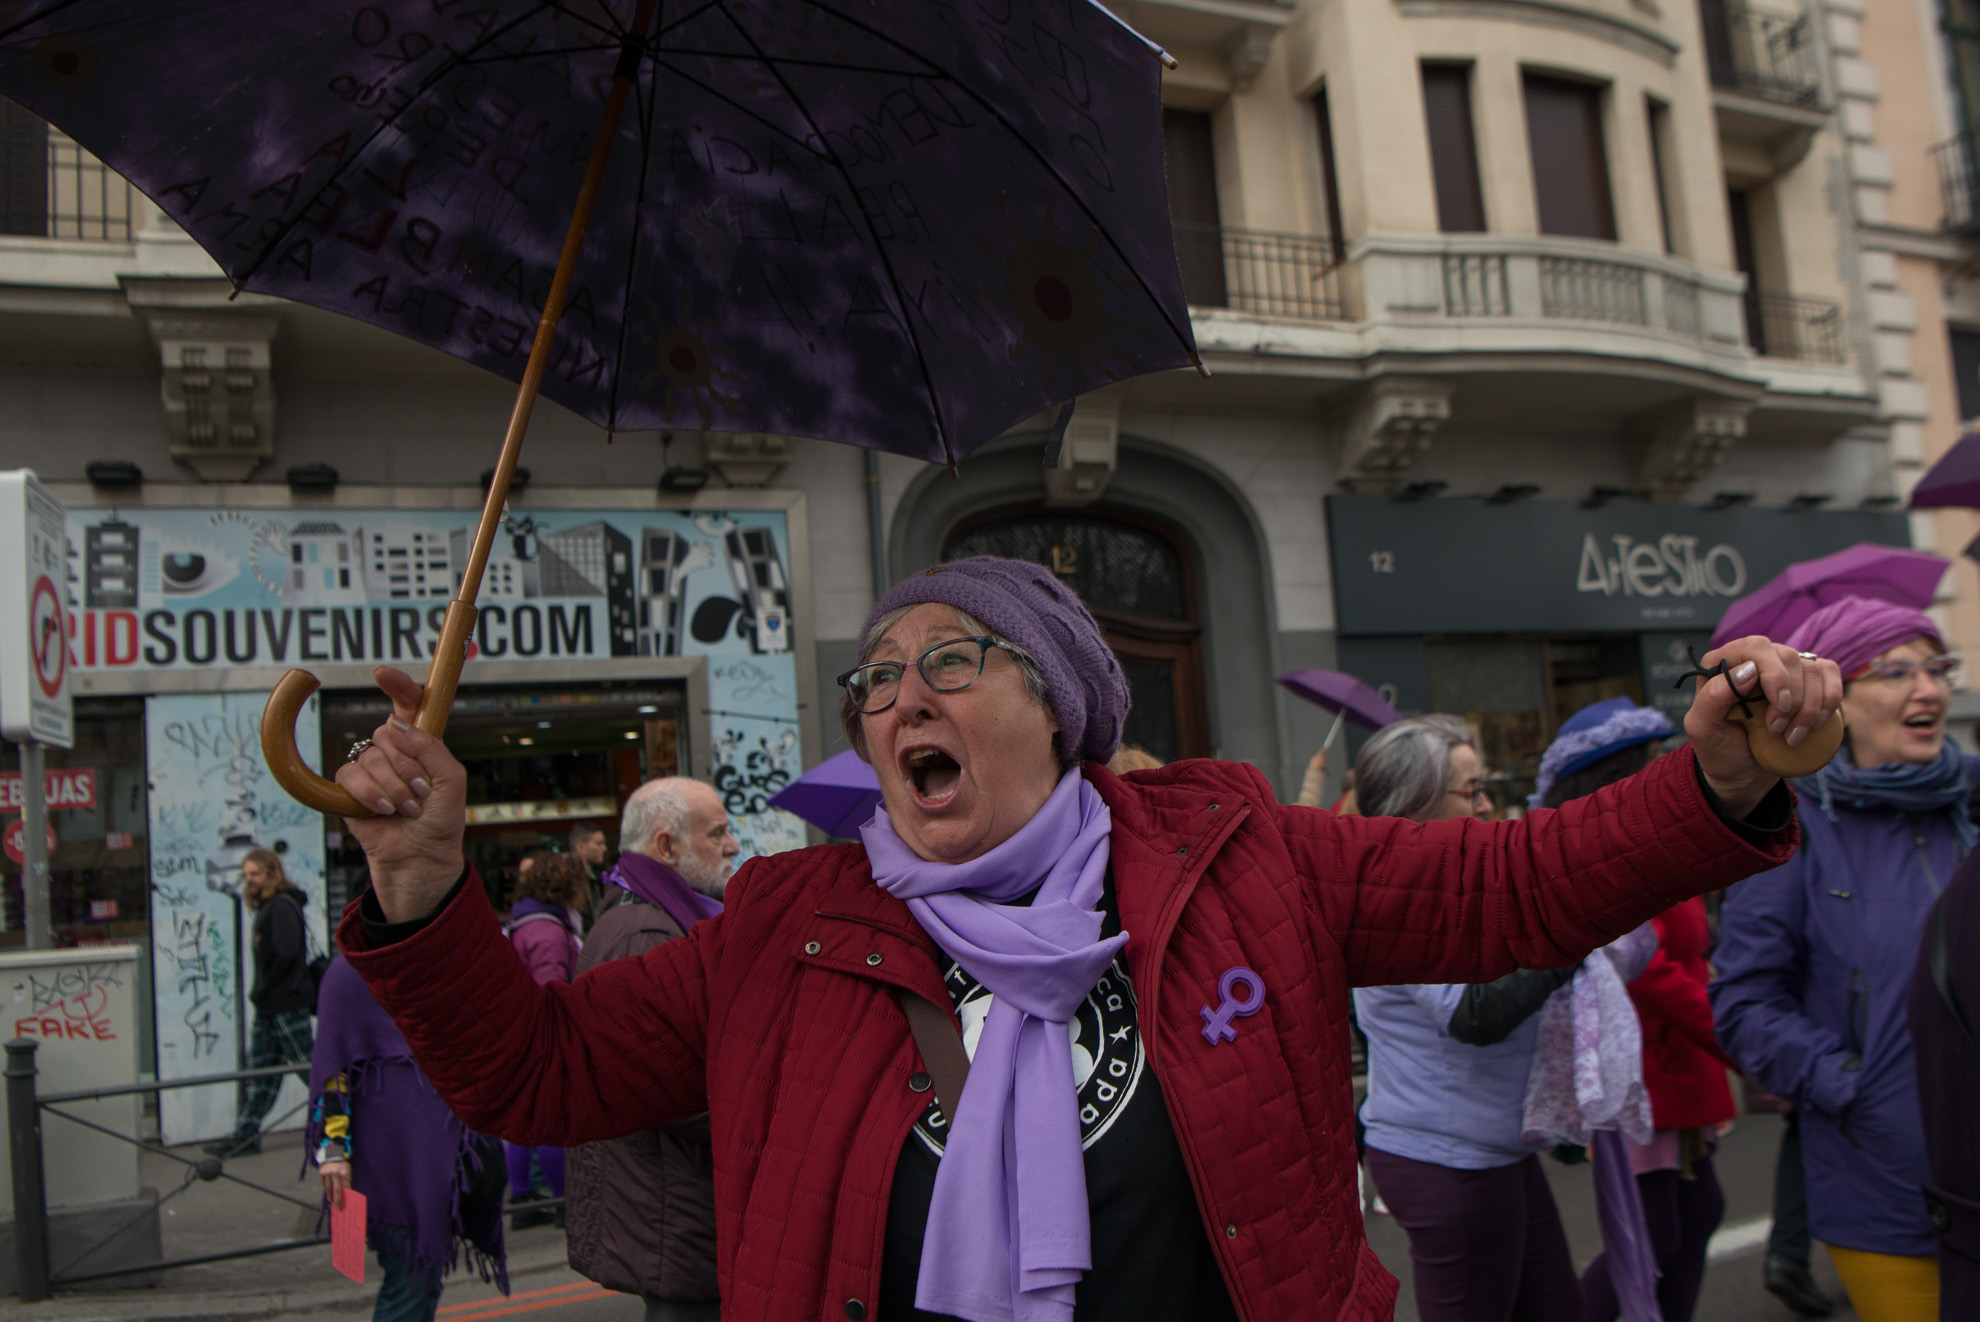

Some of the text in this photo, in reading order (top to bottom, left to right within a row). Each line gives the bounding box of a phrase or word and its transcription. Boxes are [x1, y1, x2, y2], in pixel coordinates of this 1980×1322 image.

[1052, 544, 1077, 574] 12
[1368, 550, 1396, 573] 12
[14, 1016, 116, 1041] FAKE
